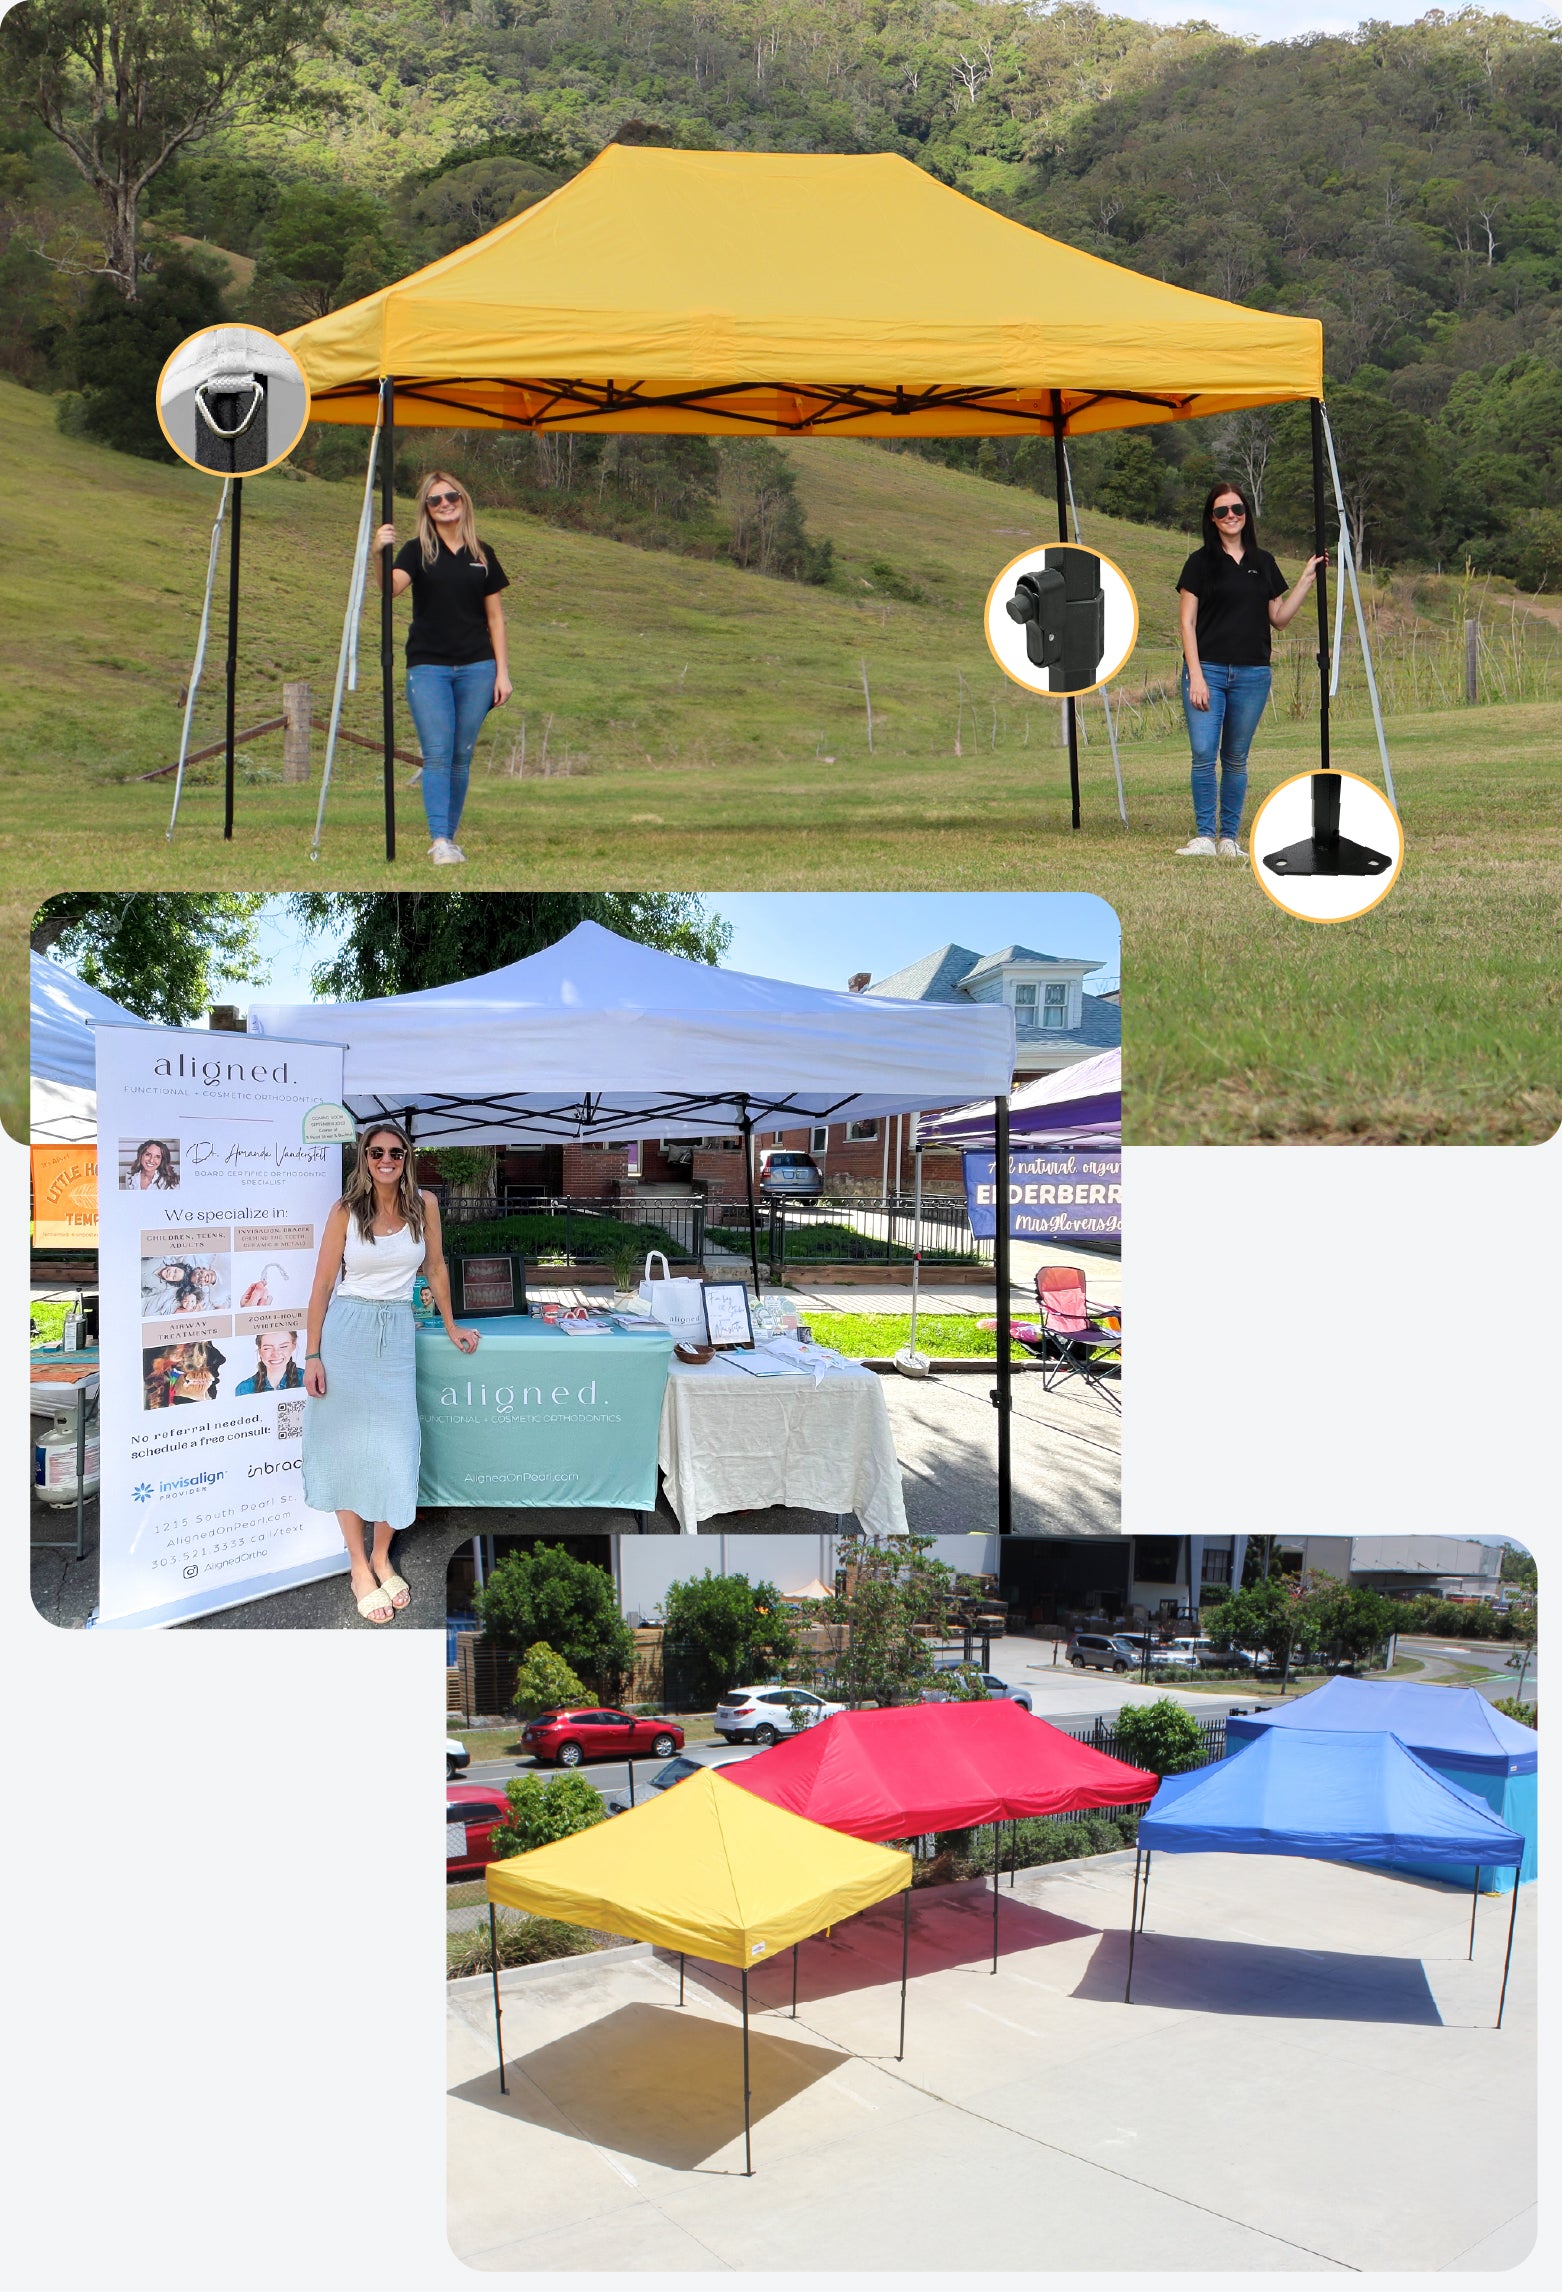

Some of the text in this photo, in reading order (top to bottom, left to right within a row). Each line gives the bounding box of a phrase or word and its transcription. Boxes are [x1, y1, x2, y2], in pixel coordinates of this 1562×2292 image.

[154, 1053, 297, 1086] aligned.
[124, 1085, 189, 1096] FUNCTIONAL
[202, 1090, 251, 1100] COSMETIC
[254, 1093, 324, 1104] ORTHODONTICS
[46, 1165, 82, 1204] LITTLE
[164, 1207, 288, 1223] We specialize in:
[146, 1233, 194, 1242] CHILDREN,
[169, 1241, 205, 1249] ADULTS
[169, 1320, 207, 1331] AIRWAY
[248, 1314, 271, 1323] ZOOM
[158, 1328, 218, 1341] TREATMENTS
[440, 1380, 609, 1414] aligned.
[420, 1414, 480, 1424] FUNCTIONAL
[491, 1414, 541, 1424] COSMETIC
[543, 1414, 622, 1423] ORTHODONTICS
[131, 1434, 149, 1445] No
[154, 1423, 210, 1440] referral
[131, 1426, 271, 1460] schedule a free consult:
[159, 1470, 225, 1493] invisalign
[464, 1472, 579, 1484] AlignedOnPearl.com
[159, 1486, 207, 1501] PROVIDER
[154, 1494, 297, 1535] 1215 South Pearl St.
[166, 1511, 292, 1548] AlignedOnPearl.com
[151, 1523, 304, 1570] 303.521.3333 call/text
[204, 1549, 268, 1573] AlignedOrtho
